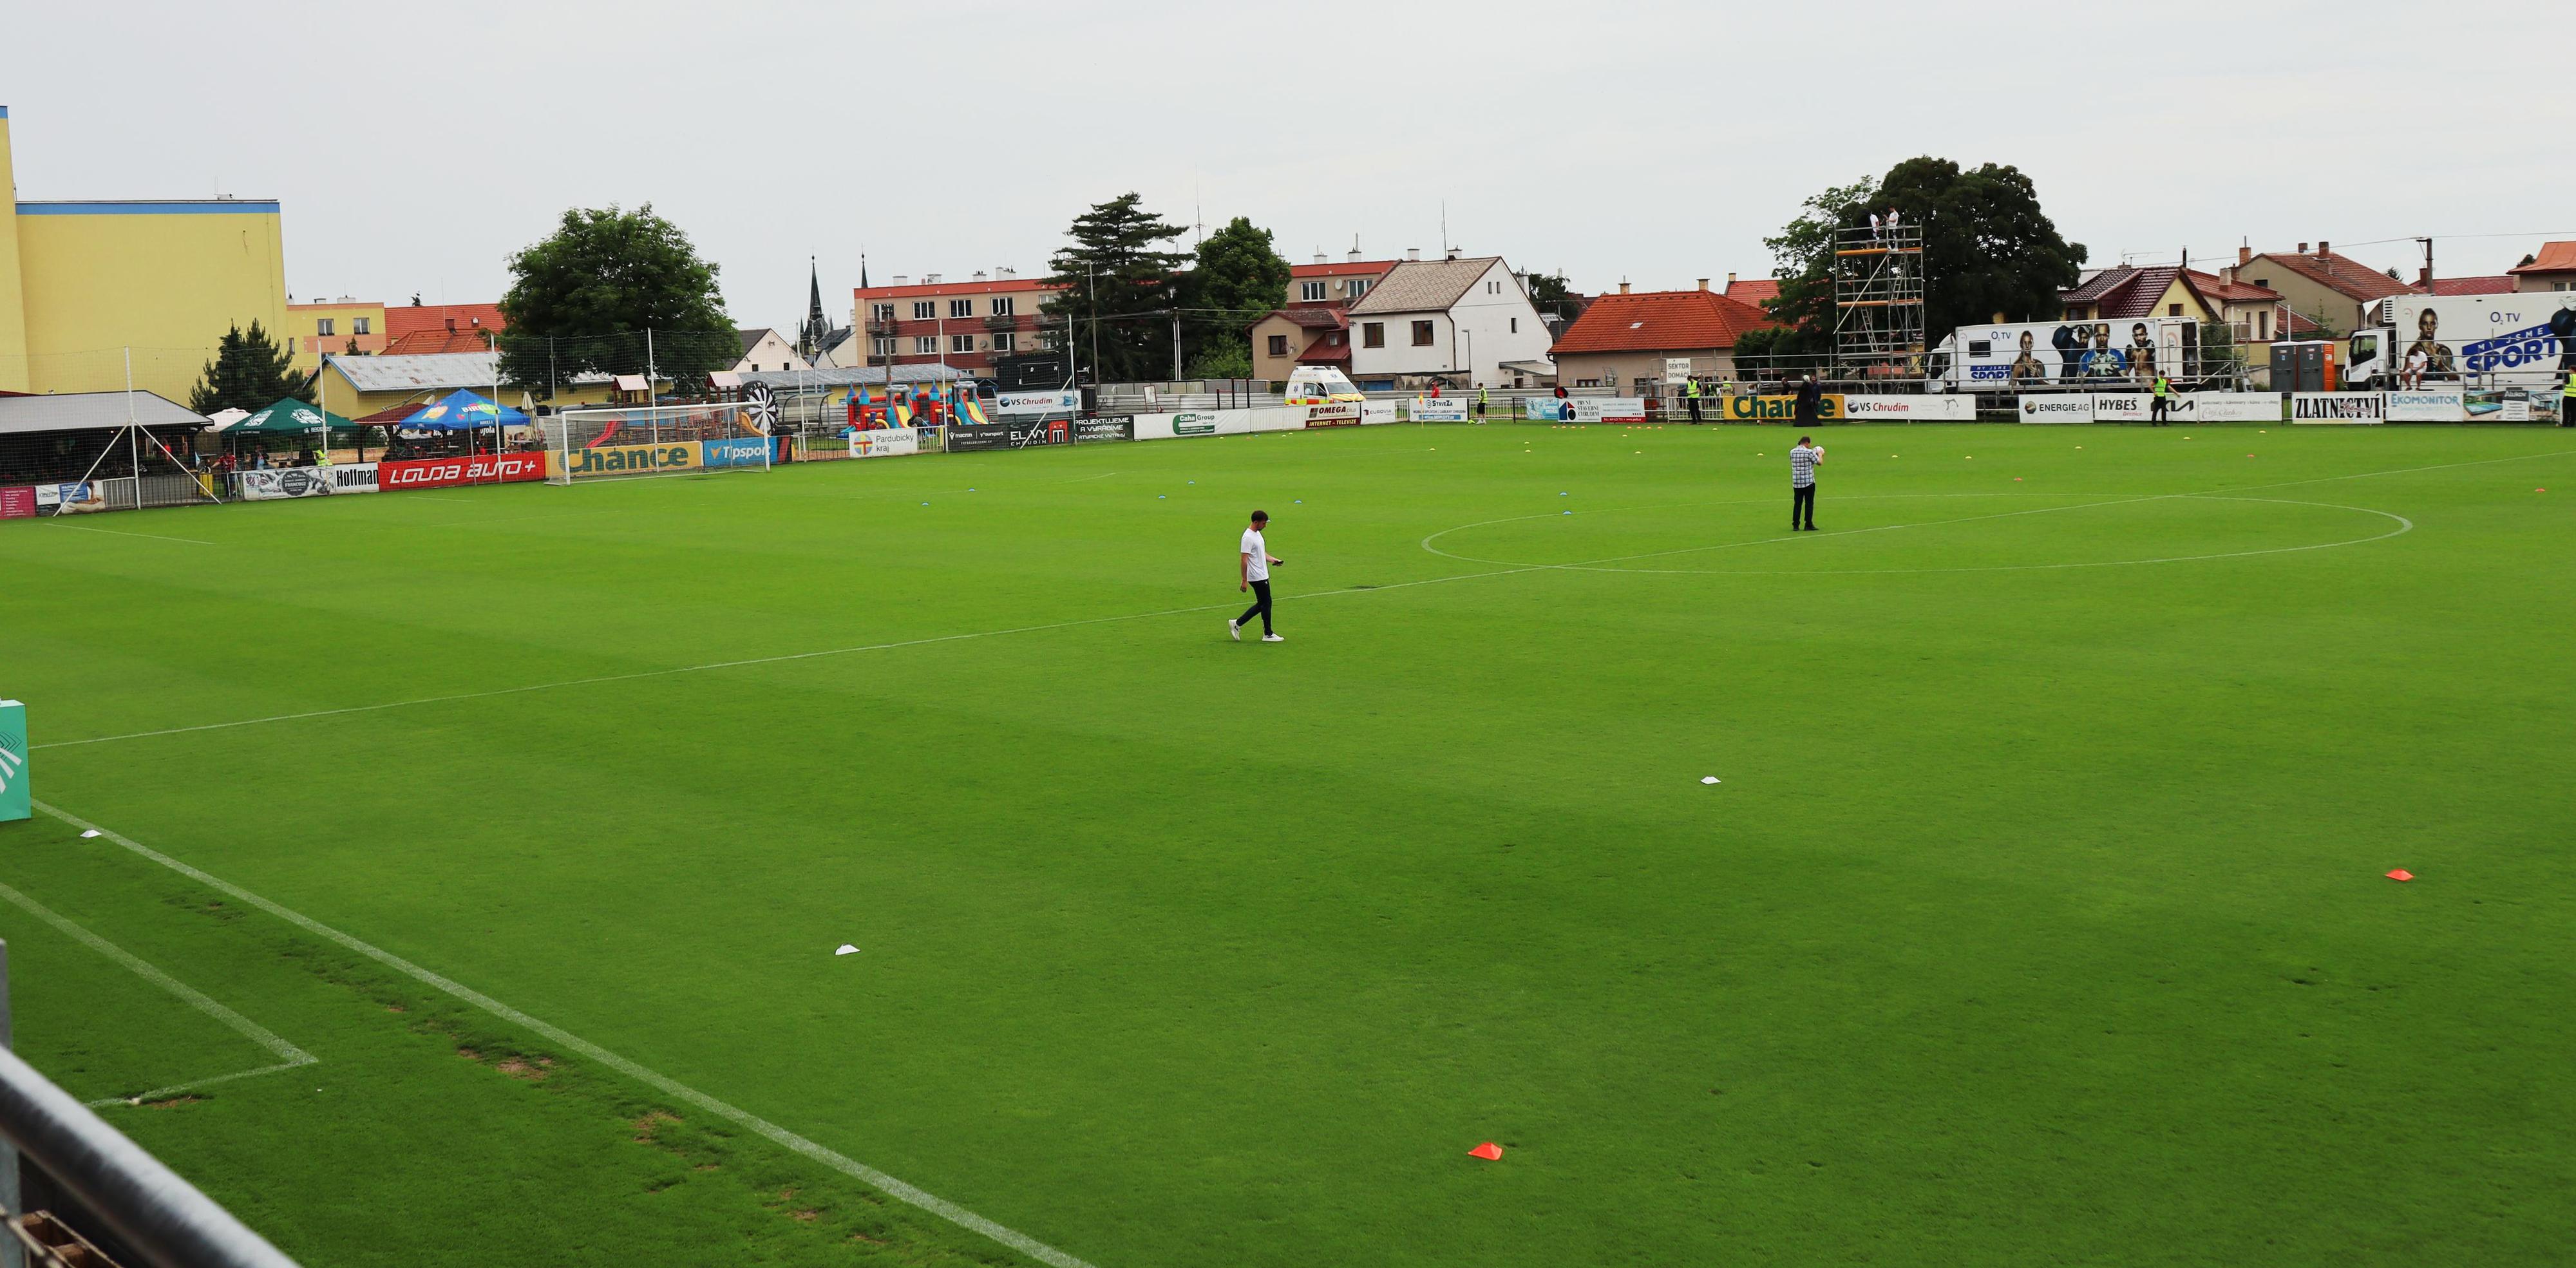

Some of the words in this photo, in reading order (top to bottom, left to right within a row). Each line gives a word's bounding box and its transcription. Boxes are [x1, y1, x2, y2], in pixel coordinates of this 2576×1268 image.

[2506, 313, 2521, 322] TV
[2506, 327, 2544, 344] JSME
[2466, 339, 2555, 378] SPORT
[1733, 396, 1835, 418] Chane
[1860, 402, 1871, 411] VS
[1873, 402, 1909, 412] Chrudim
[2099, 397, 2137, 411] HYBEŠ
[2295, 393, 2381, 419] ZLATNICTVÍ
[2391, 393, 2460, 407] EKOMONITOR
[1319, 406, 1346, 414] OMEGA
[876, 433, 914, 443] Pardubický
[723, 444, 771, 460] Tipsport
[876, 444, 889, 453] kraj
[558, 447, 688, 473] Chance
